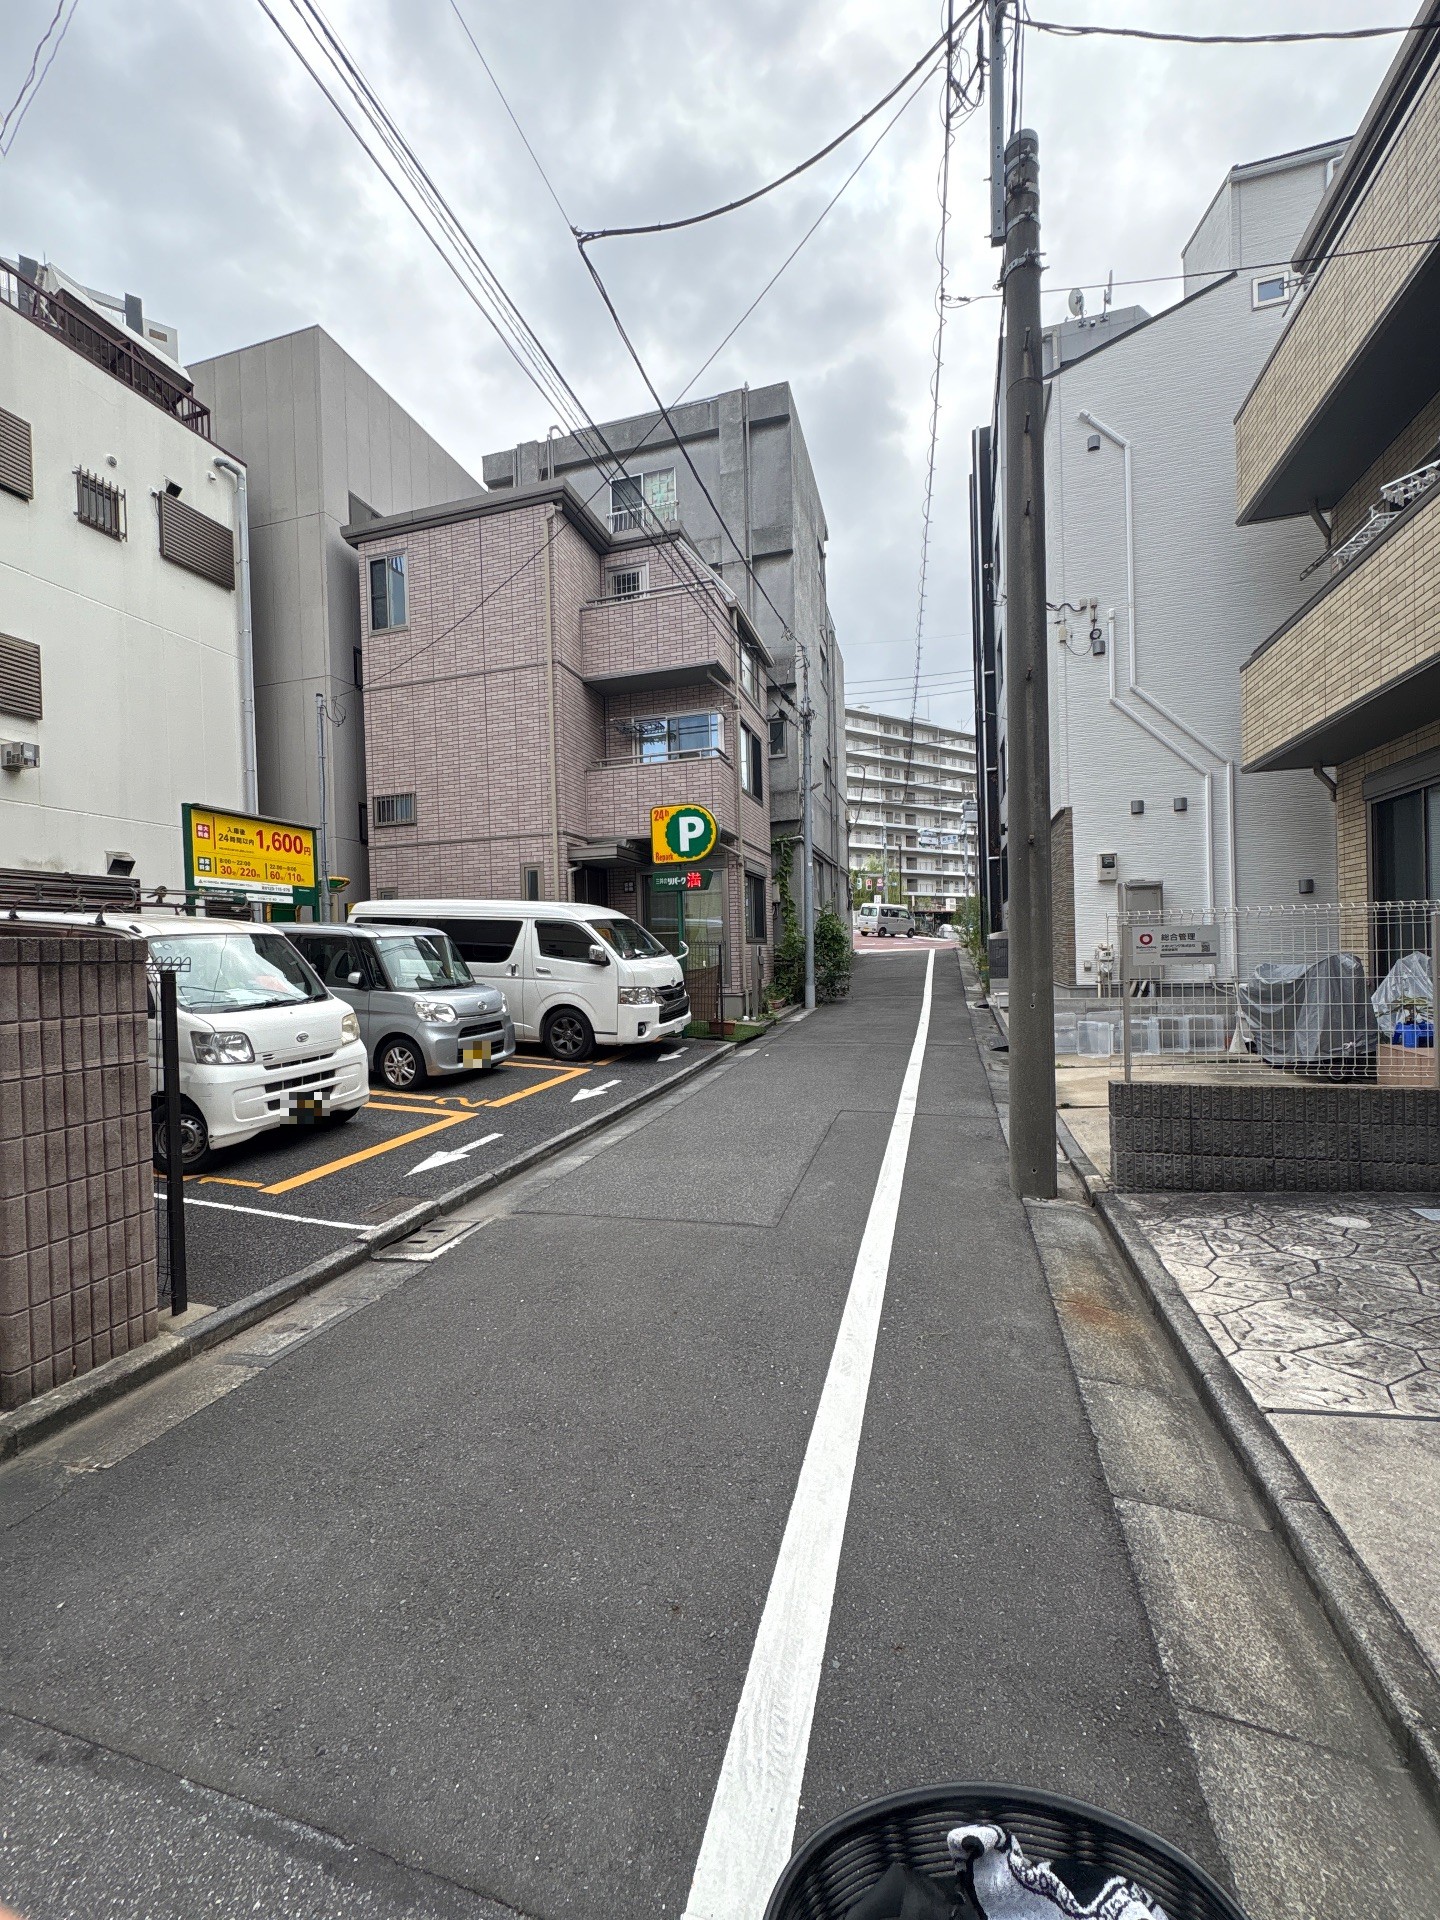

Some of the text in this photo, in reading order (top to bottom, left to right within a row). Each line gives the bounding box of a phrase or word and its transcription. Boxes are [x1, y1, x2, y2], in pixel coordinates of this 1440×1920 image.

[218, 833, 255, 846] 24時間以内
[678, 816, 705, 852] P
[255, 829, 311, 856] 1,600円
[655, 852, 674, 862] Repark
[687, 872, 702, 888] 満
[1160, 932, 1196, 941] 総合管理
